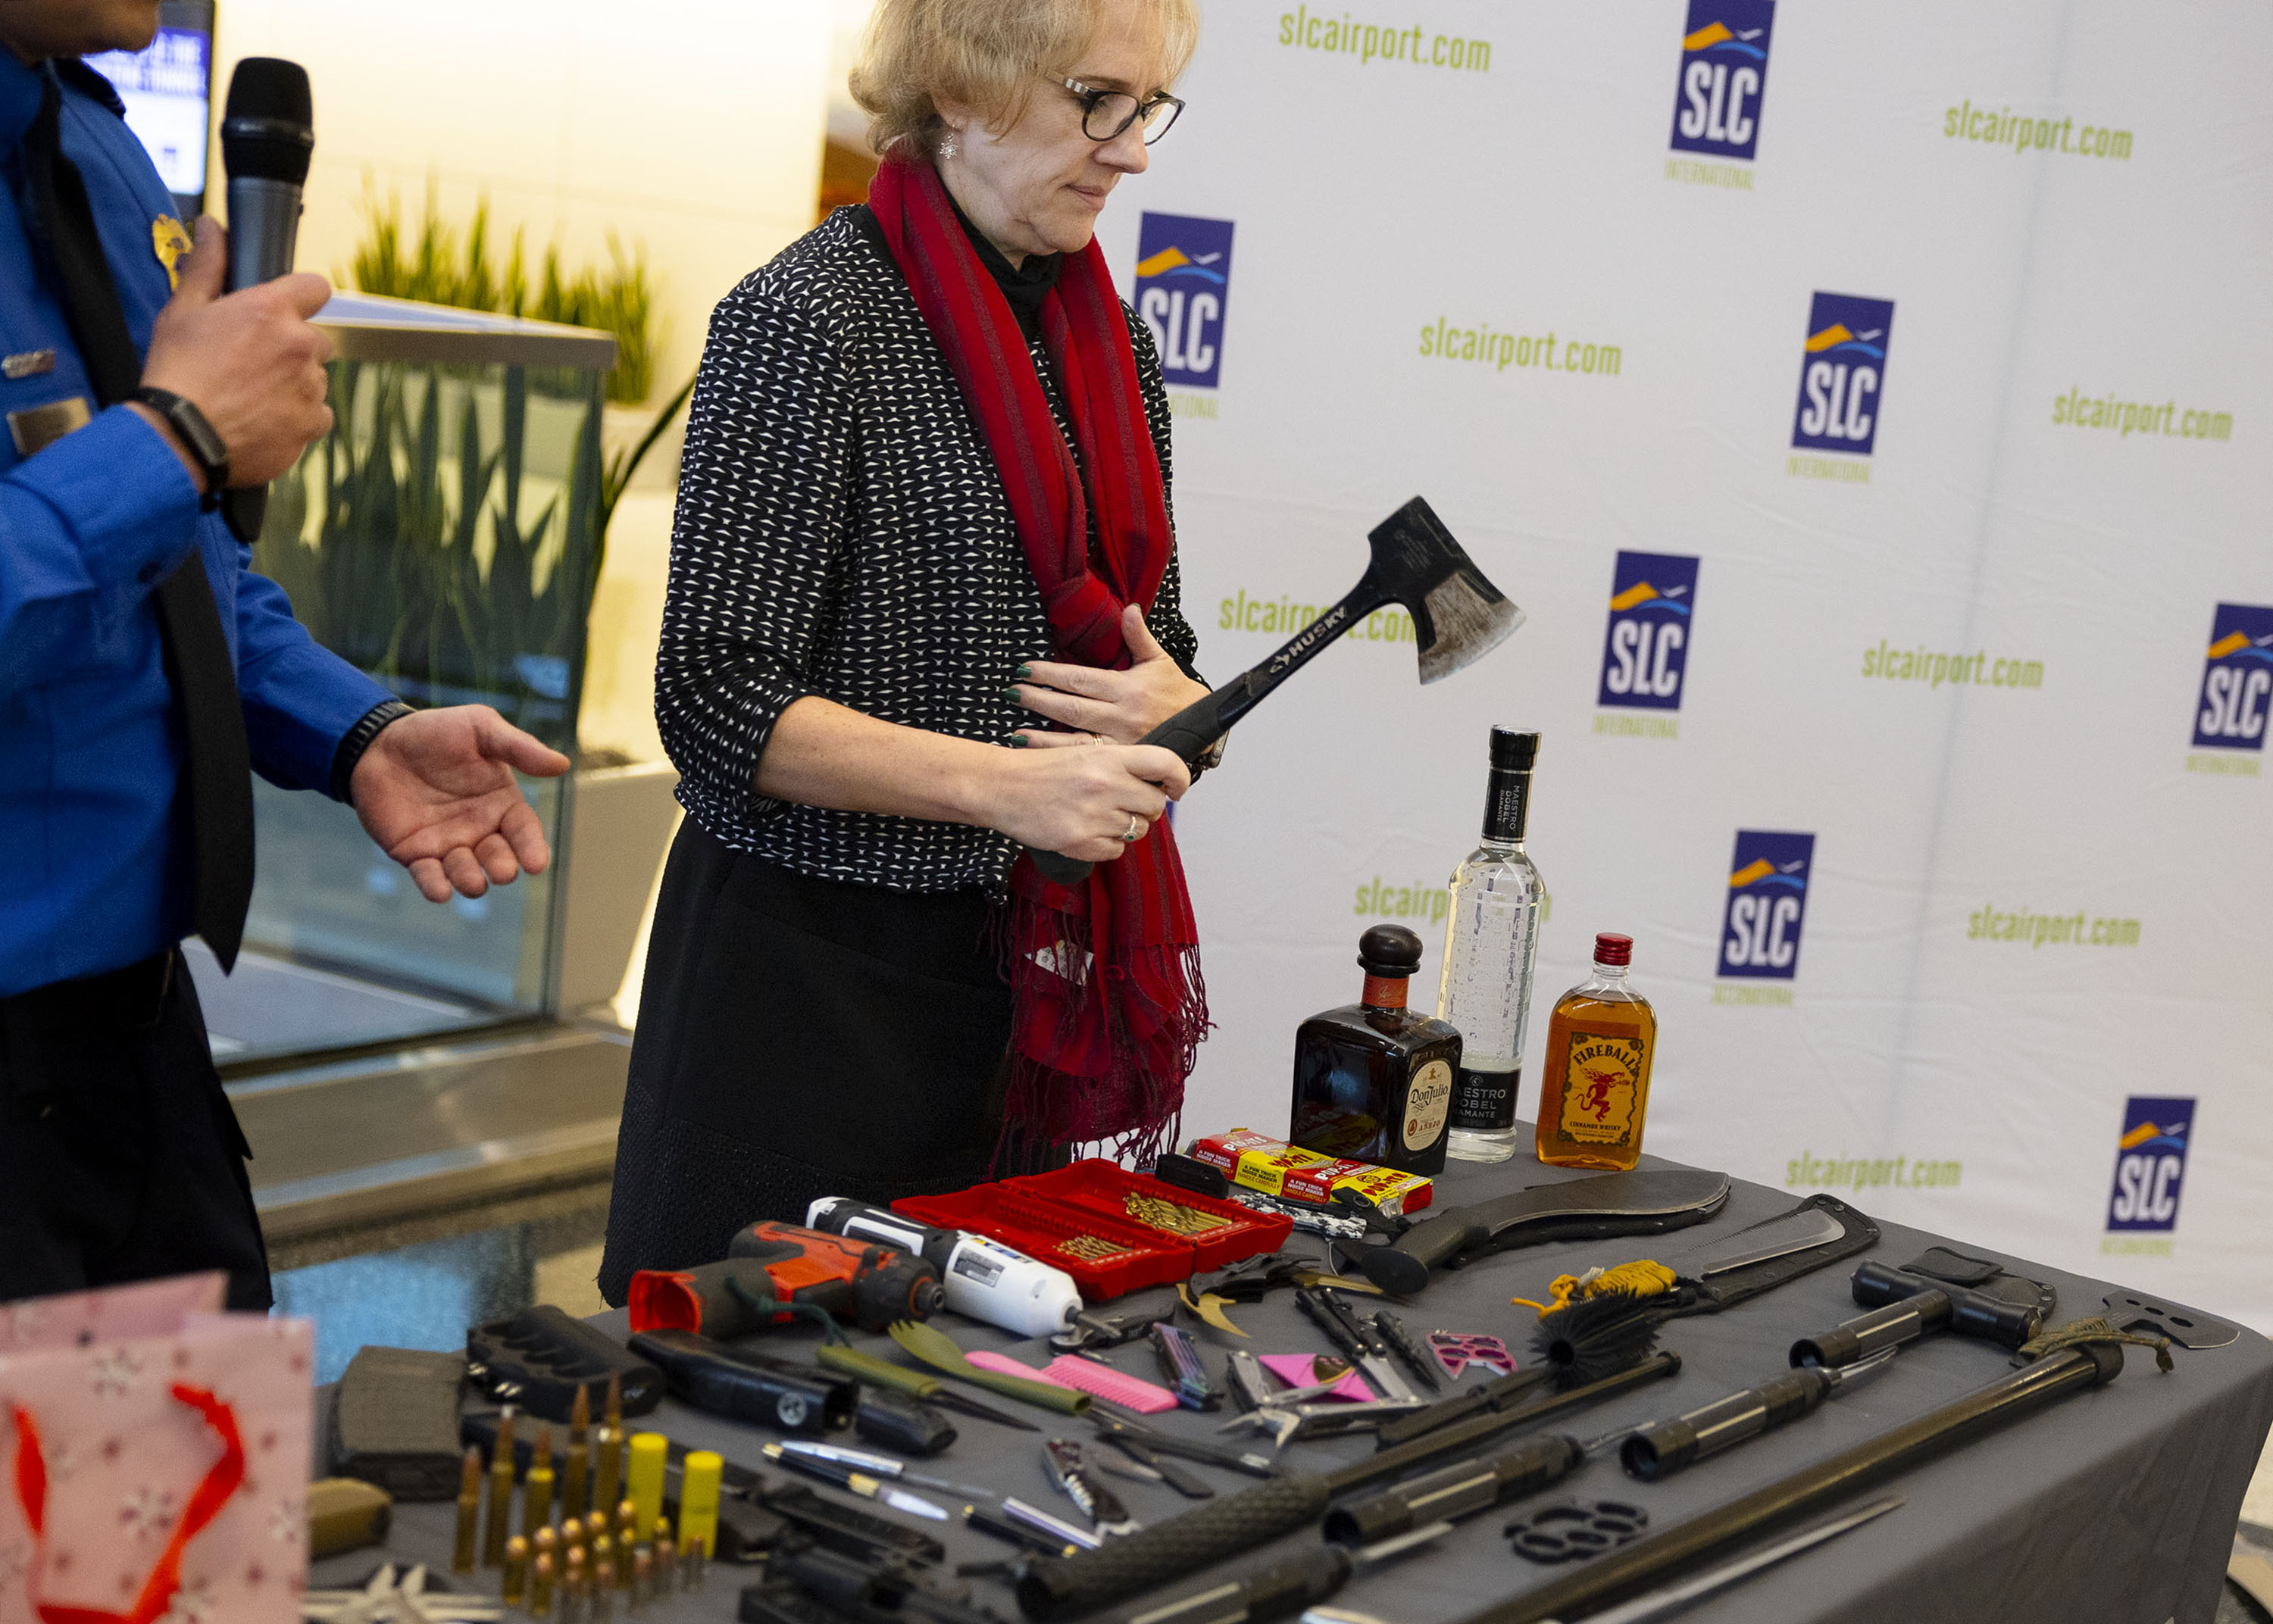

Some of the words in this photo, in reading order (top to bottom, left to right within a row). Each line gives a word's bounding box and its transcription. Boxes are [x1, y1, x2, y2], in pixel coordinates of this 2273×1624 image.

[1278, 5, 1492, 72] slcairport.com
[1680, 61, 1759, 145] SLC
[1943, 99, 2134, 161] slcairport.com
[1139, 286, 1219, 373] SLC
[1418, 316, 1622, 376] slcairport.com
[1801, 361, 1877, 441] SLC
[2052, 386, 2234, 441] slcairport.com
[1288, 607, 1345, 657] HUSKY
[1608, 620, 1684, 697] SLC
[1861, 639, 2045, 690] slcairport.com
[2200, 667, 2270, 739] SLC
[1502, 790, 1512, 823] DOBEL
[1509, 785, 1521, 830] MAESTRO
[1726, 895, 1799, 967] SLC
[1967, 904, 2141, 949] slcairport.com
[1573, 1044, 1636, 1070] FIREBALL
[1455, 1086, 1506, 1099] AESTRO
[1455, 1098, 1497, 1110] OBEL
[1785, 1150, 1963, 1194] slcairport.com
[2114, 1155, 2181, 1221] SLC
